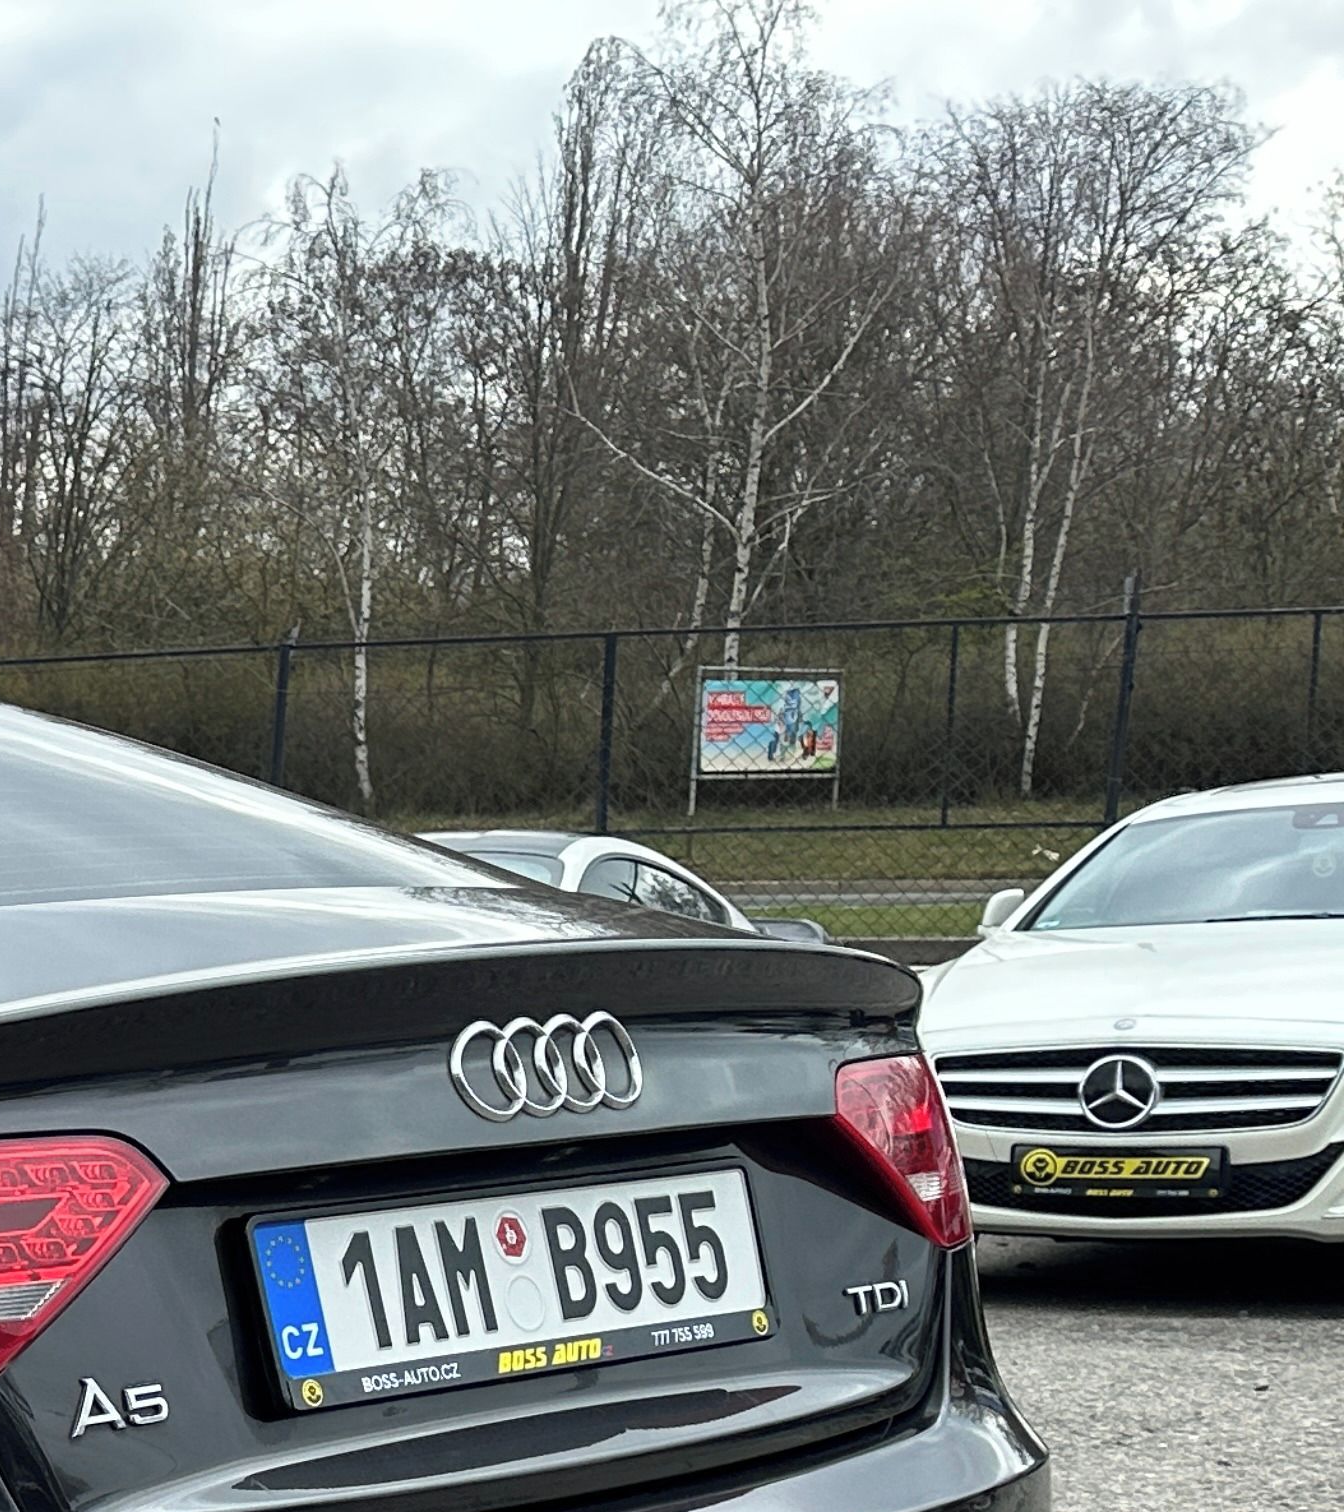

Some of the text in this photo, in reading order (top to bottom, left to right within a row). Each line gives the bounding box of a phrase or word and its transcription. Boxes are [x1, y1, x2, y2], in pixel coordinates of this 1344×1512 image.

[1062, 1160, 1205, 1175] BOSS AUTO
[341, 1190, 729, 1350] 1AM B955
[843, 1279, 909, 1315] TDI
[282, 1322, 324, 1360] CZ
[362, 1362, 461, 1393] BOSS-AUTO.CZ
[498, 1348, 547, 1374] BOSS
[552, 1338, 602, 1367] AUTO
[651, 1330, 669, 1346] 777
[673, 1326, 692, 1343] 755
[694, 1323, 714, 1340] 599
[70, 1377, 169, 1438] A5
